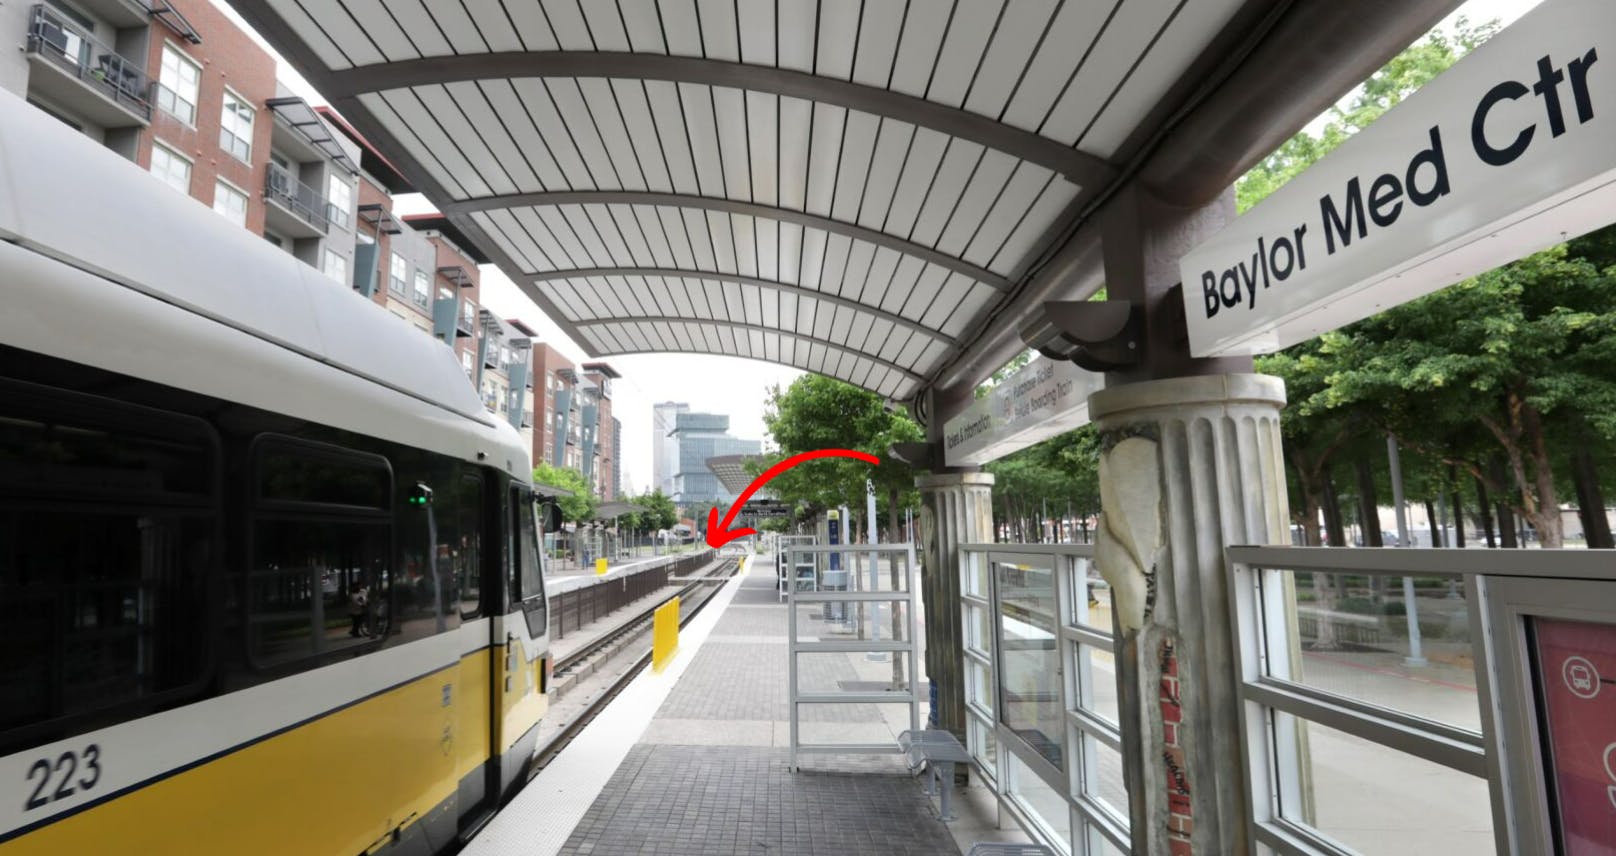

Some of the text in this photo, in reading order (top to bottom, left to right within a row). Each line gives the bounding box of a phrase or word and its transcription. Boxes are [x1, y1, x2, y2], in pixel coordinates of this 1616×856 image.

[1202, 47, 1598, 319] Baylor Med Ctr
[24, 743, 102, 812] 223
